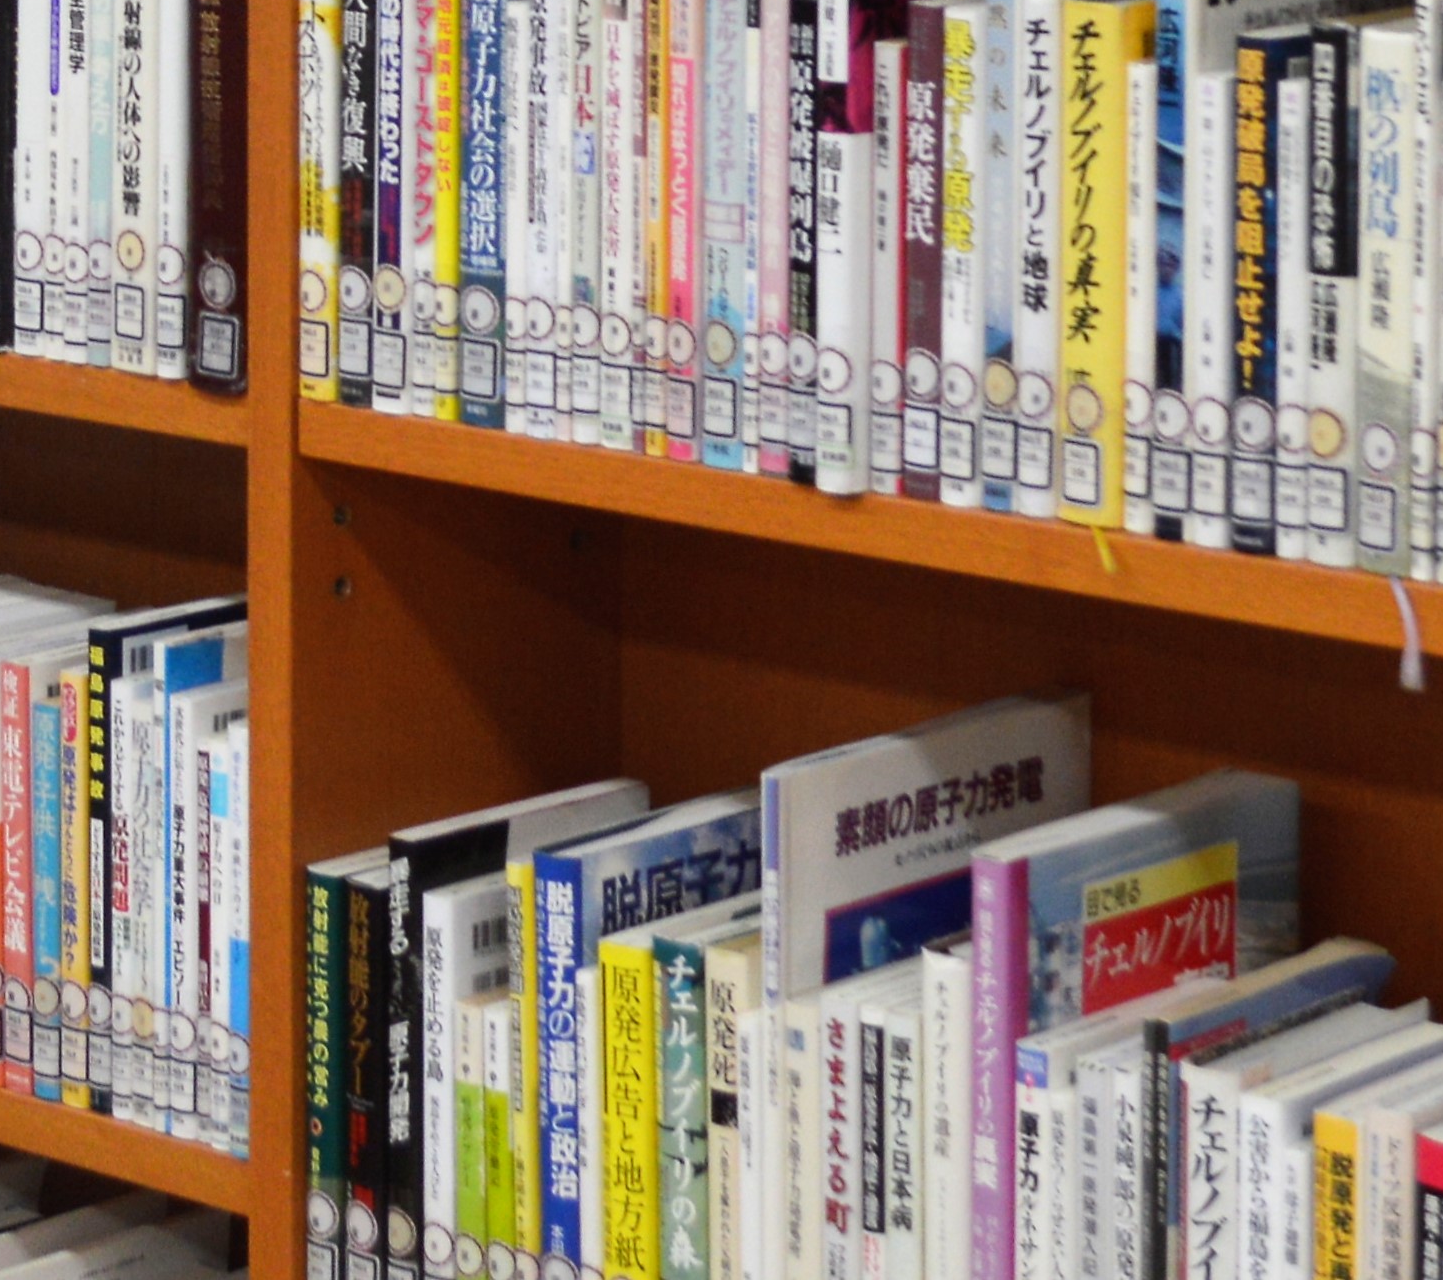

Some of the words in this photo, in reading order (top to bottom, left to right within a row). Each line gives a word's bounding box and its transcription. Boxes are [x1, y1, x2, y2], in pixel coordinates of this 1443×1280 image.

[3, 726, 28, 954] 東電テレビ会議
[835, 756, 1045, 858] 素顔の原子力発電
[612, 966, 645, 1272] 原発広告と地方紙
[668, 955, 701, 1270] チェルノブイリの森
